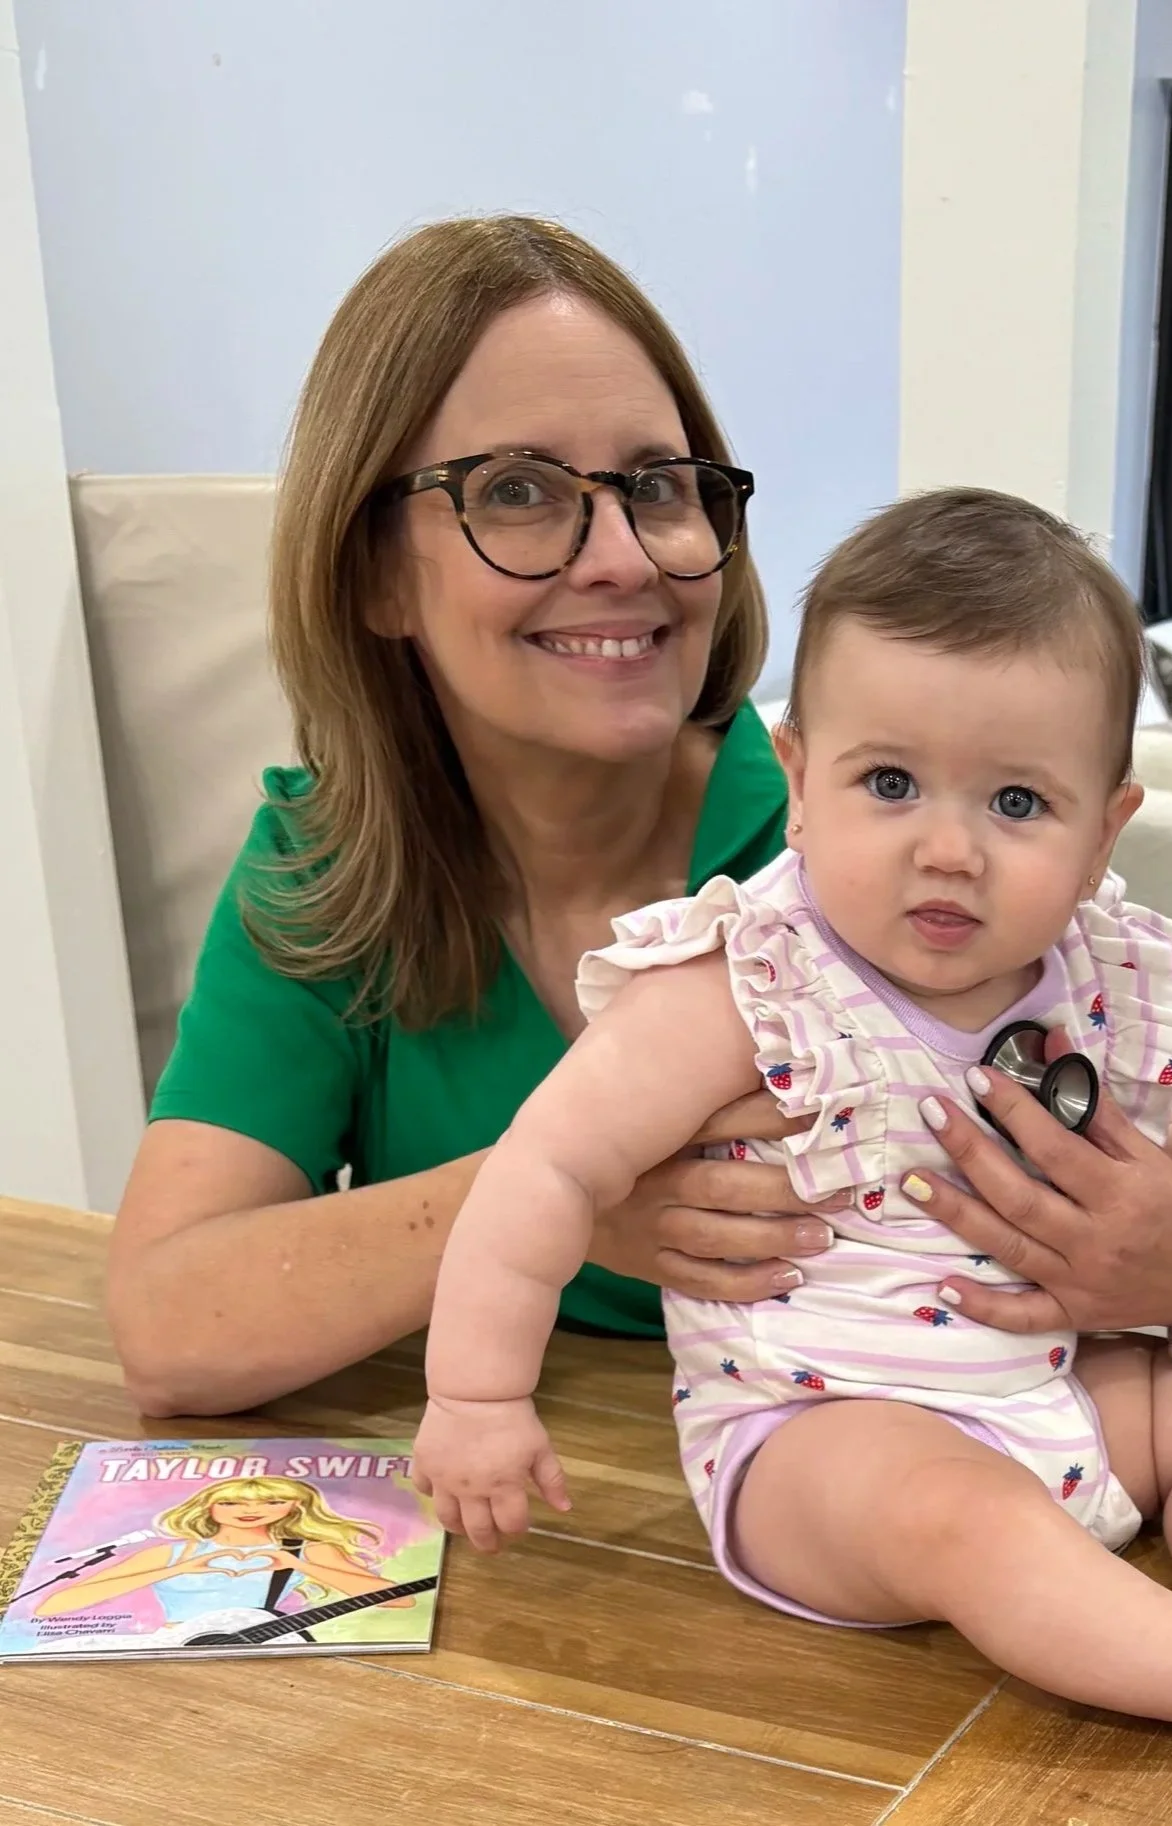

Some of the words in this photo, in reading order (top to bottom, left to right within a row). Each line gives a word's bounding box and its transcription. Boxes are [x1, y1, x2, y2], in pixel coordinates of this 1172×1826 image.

[100, 1456, 269, 1482] TAYLOR
[30, 1617, 45, 1625] By
[47, 1615, 91, 1623] Wendy
[40, 1622, 99, 1630] Illustrated
